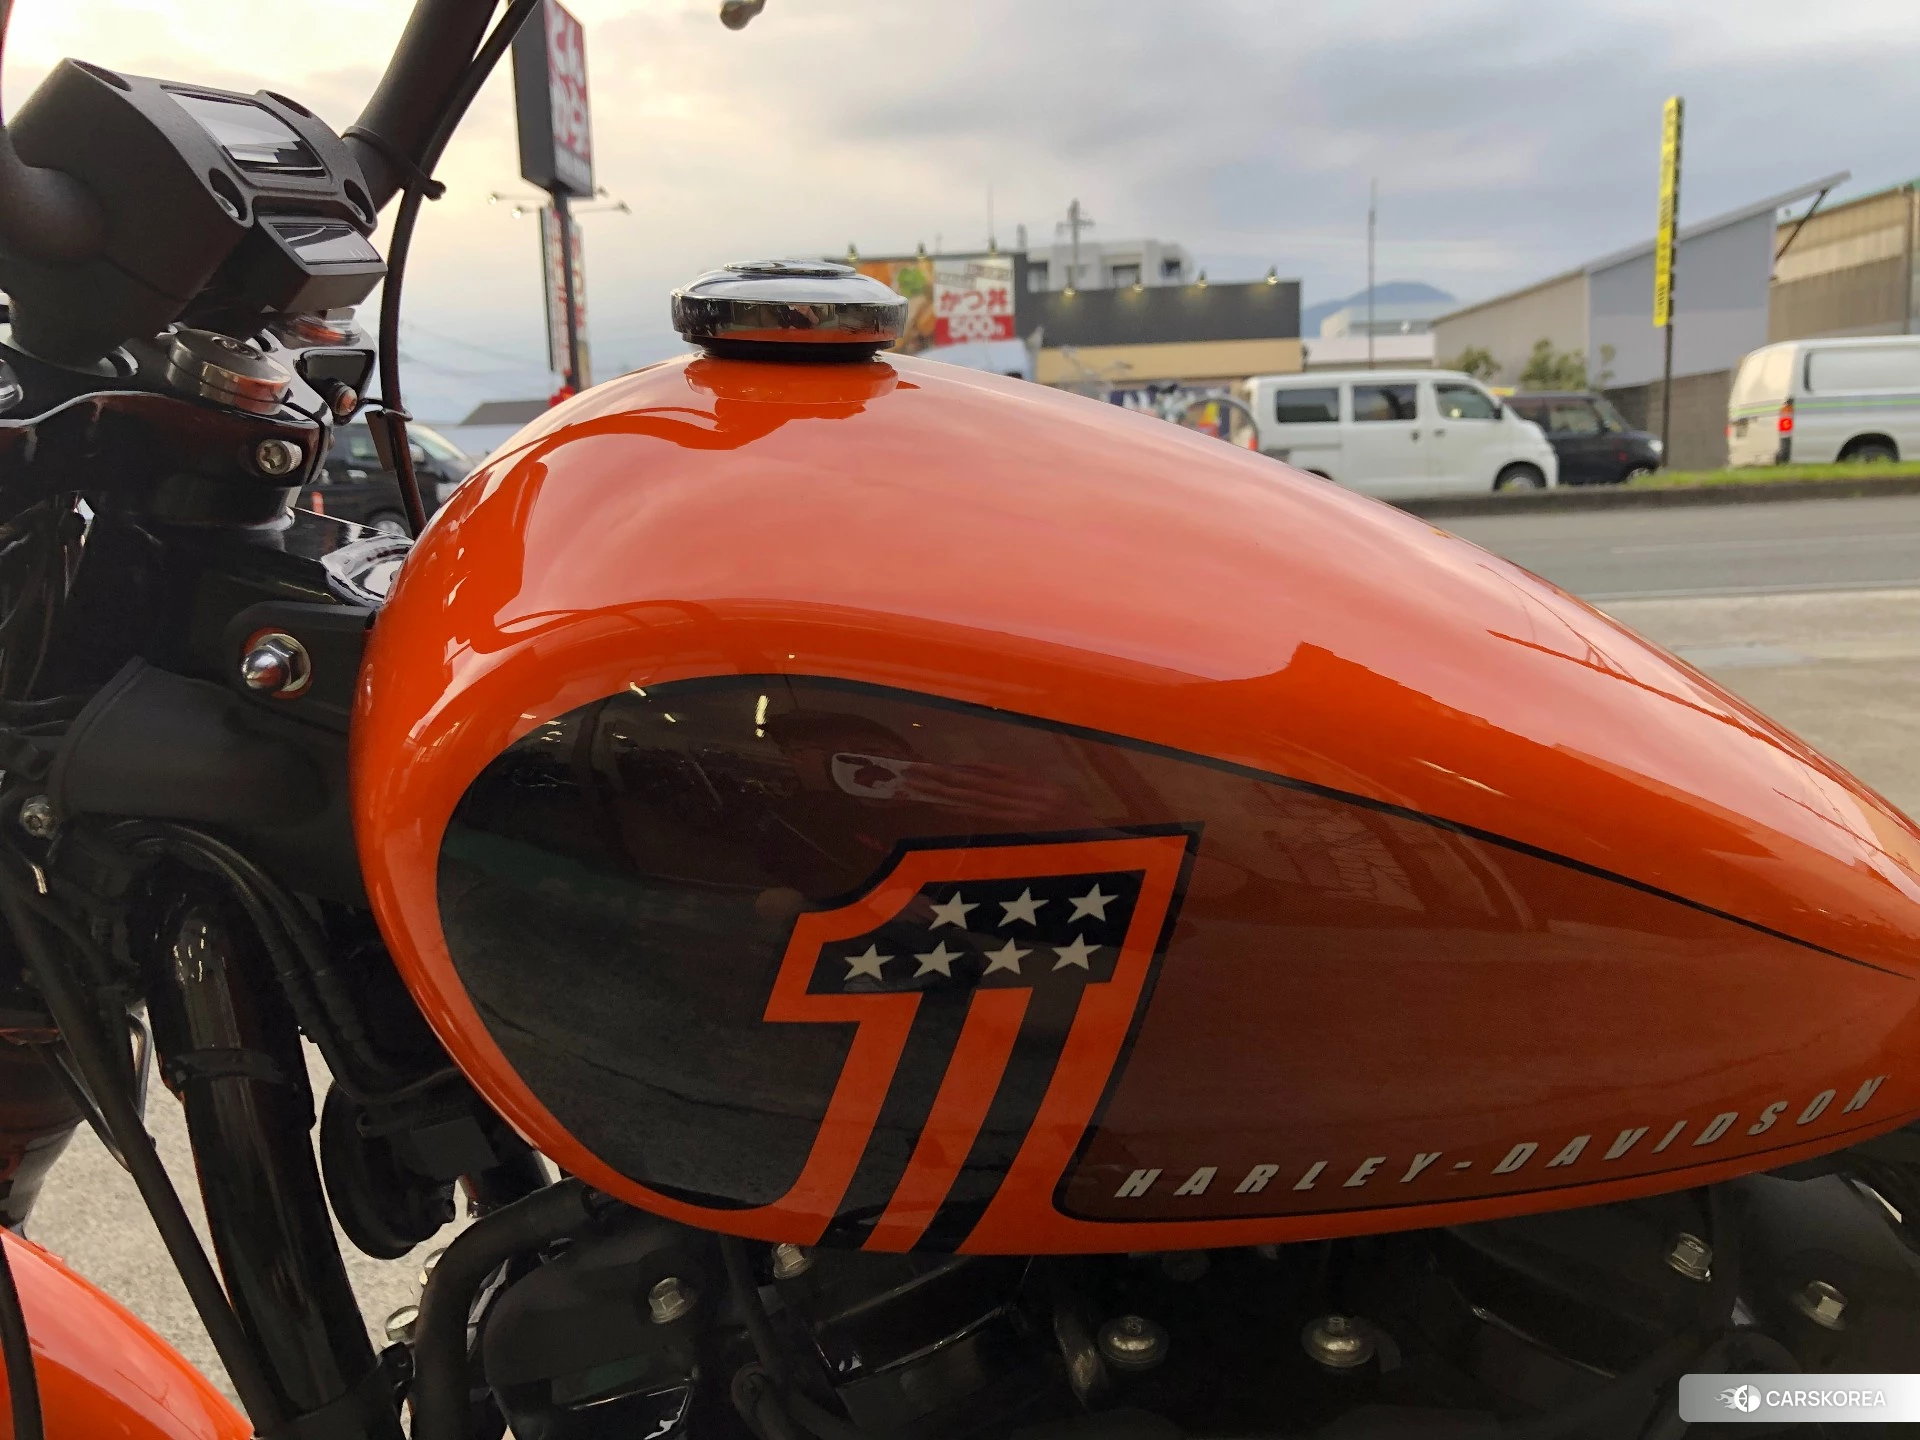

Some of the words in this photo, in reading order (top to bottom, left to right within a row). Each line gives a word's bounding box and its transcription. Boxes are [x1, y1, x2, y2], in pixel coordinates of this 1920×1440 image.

[939, 288, 1008, 314] かつ丼
[1114, 1075, 1886, 1198] HARLEY-DAVIDSON
